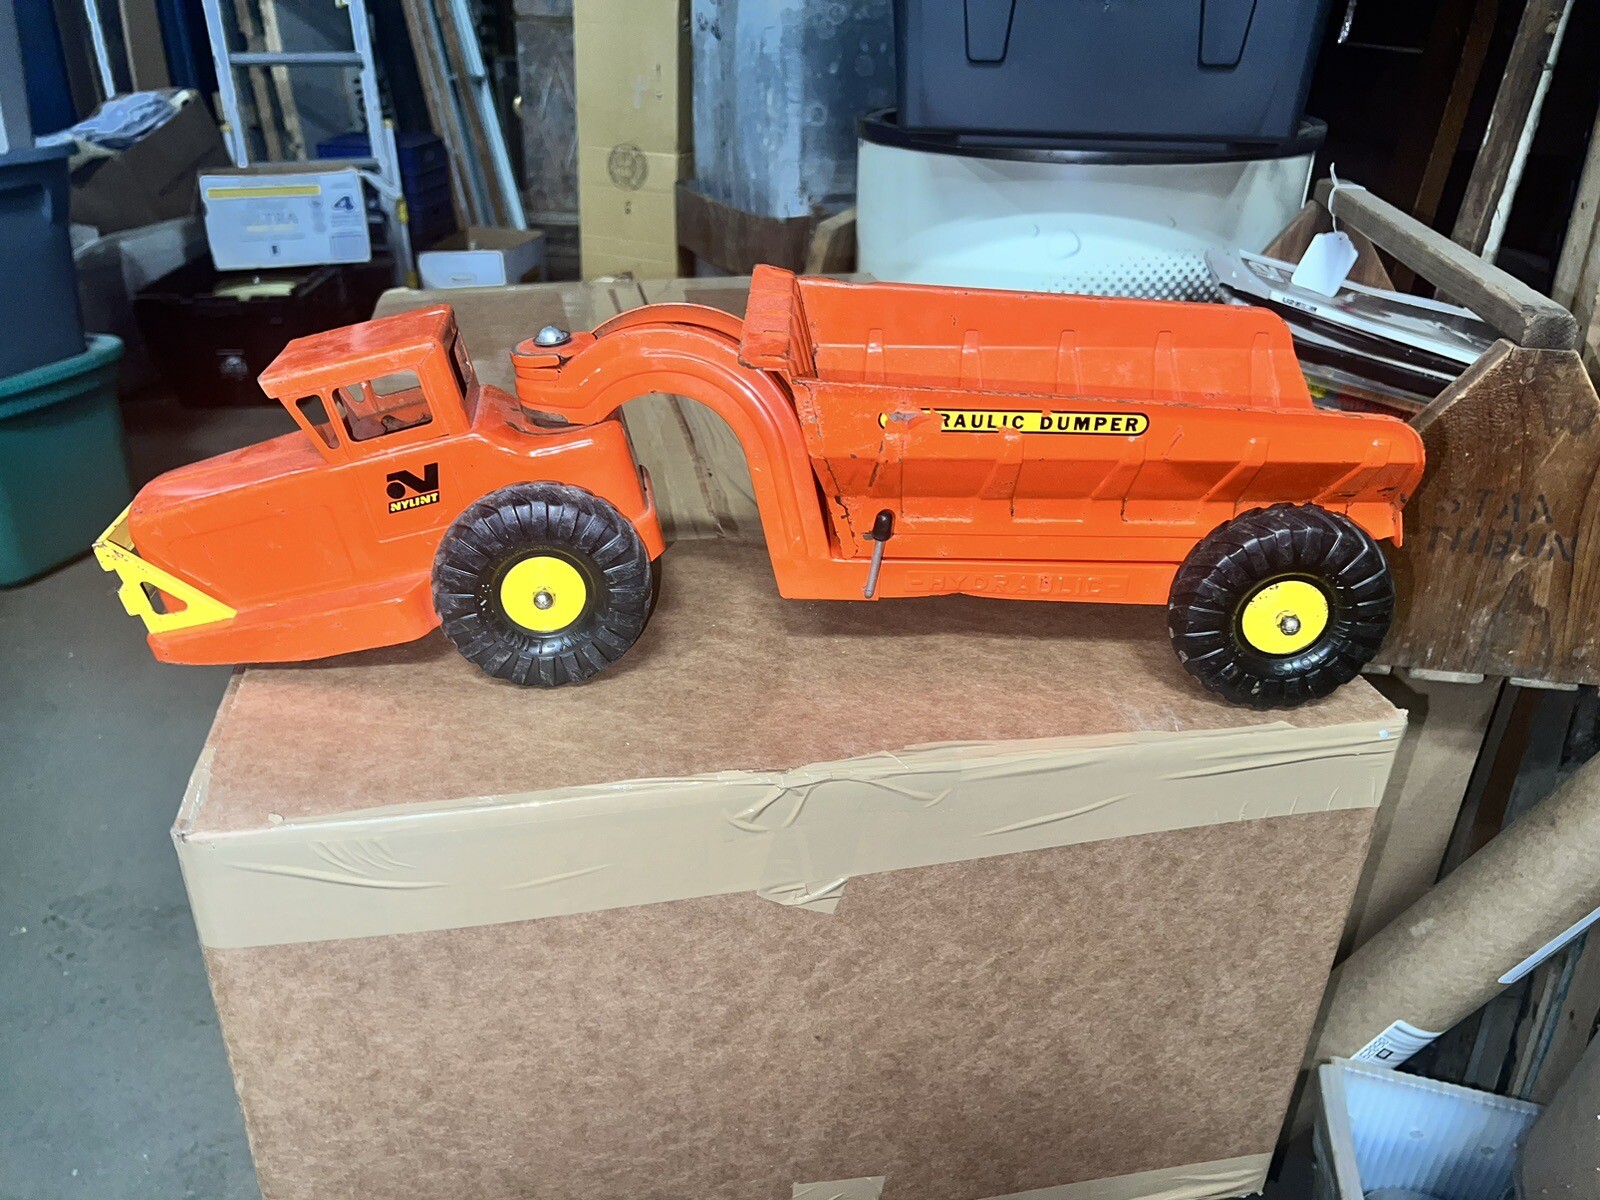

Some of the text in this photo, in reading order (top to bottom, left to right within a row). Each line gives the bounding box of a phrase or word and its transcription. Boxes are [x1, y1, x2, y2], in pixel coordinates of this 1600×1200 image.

[1039, 416, 1139, 432] DUMPER
[390, 492, 439, 512] NYLINT
[927, 574, 1101, 594] HYDRAULIC
